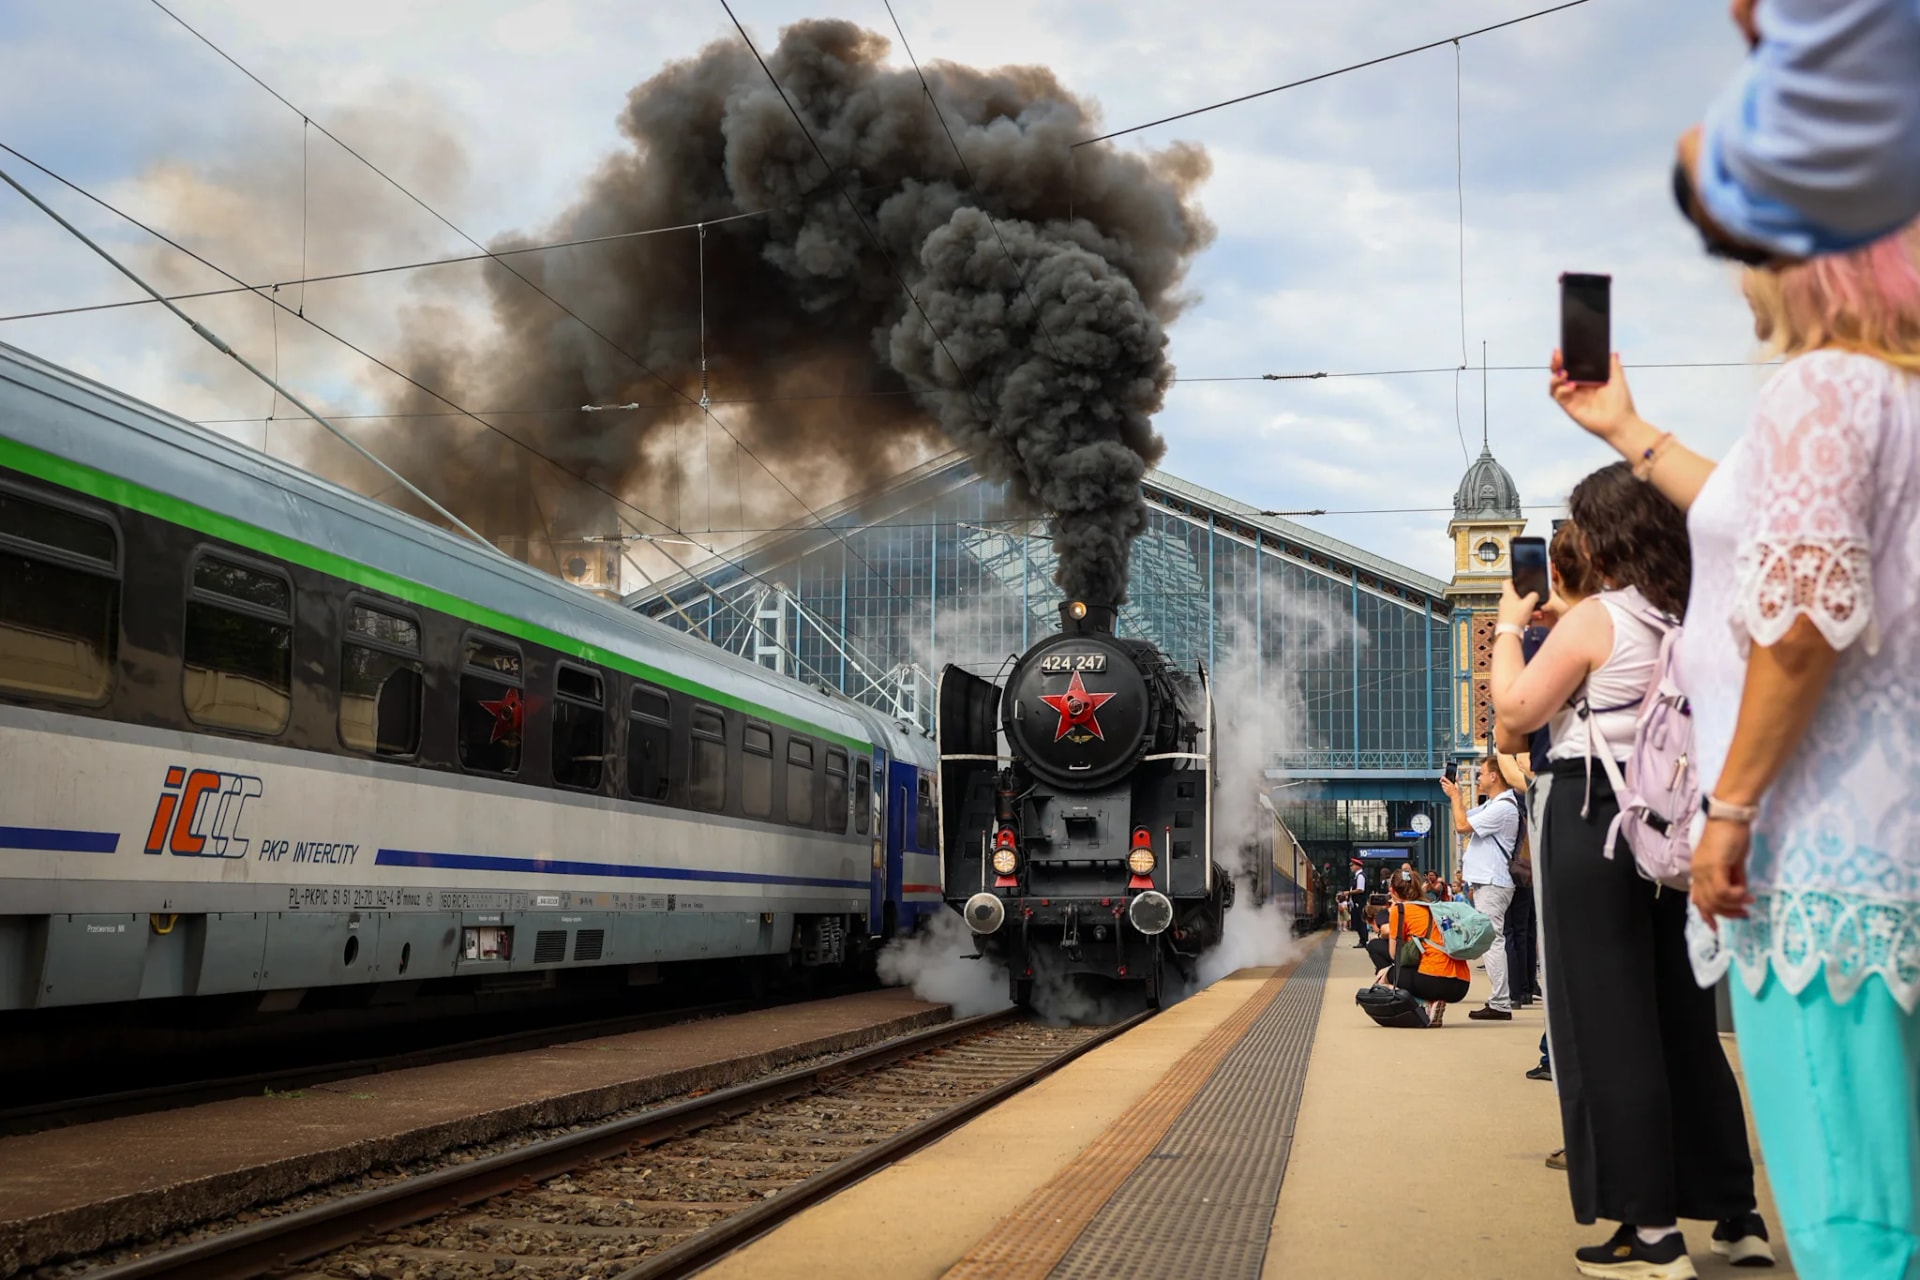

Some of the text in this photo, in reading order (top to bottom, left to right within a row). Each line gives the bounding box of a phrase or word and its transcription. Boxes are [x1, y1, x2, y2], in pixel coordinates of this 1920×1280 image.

[1042, 655, 1105, 671] 424.247
[259, 840, 359, 865] PKP INTERCITY
[1359, 849, 1368, 857] 10
[289, 888, 328, 905] PL-PKPIC
[333, 889, 340, 905] 61
[343, 889, 351, 905] 51
